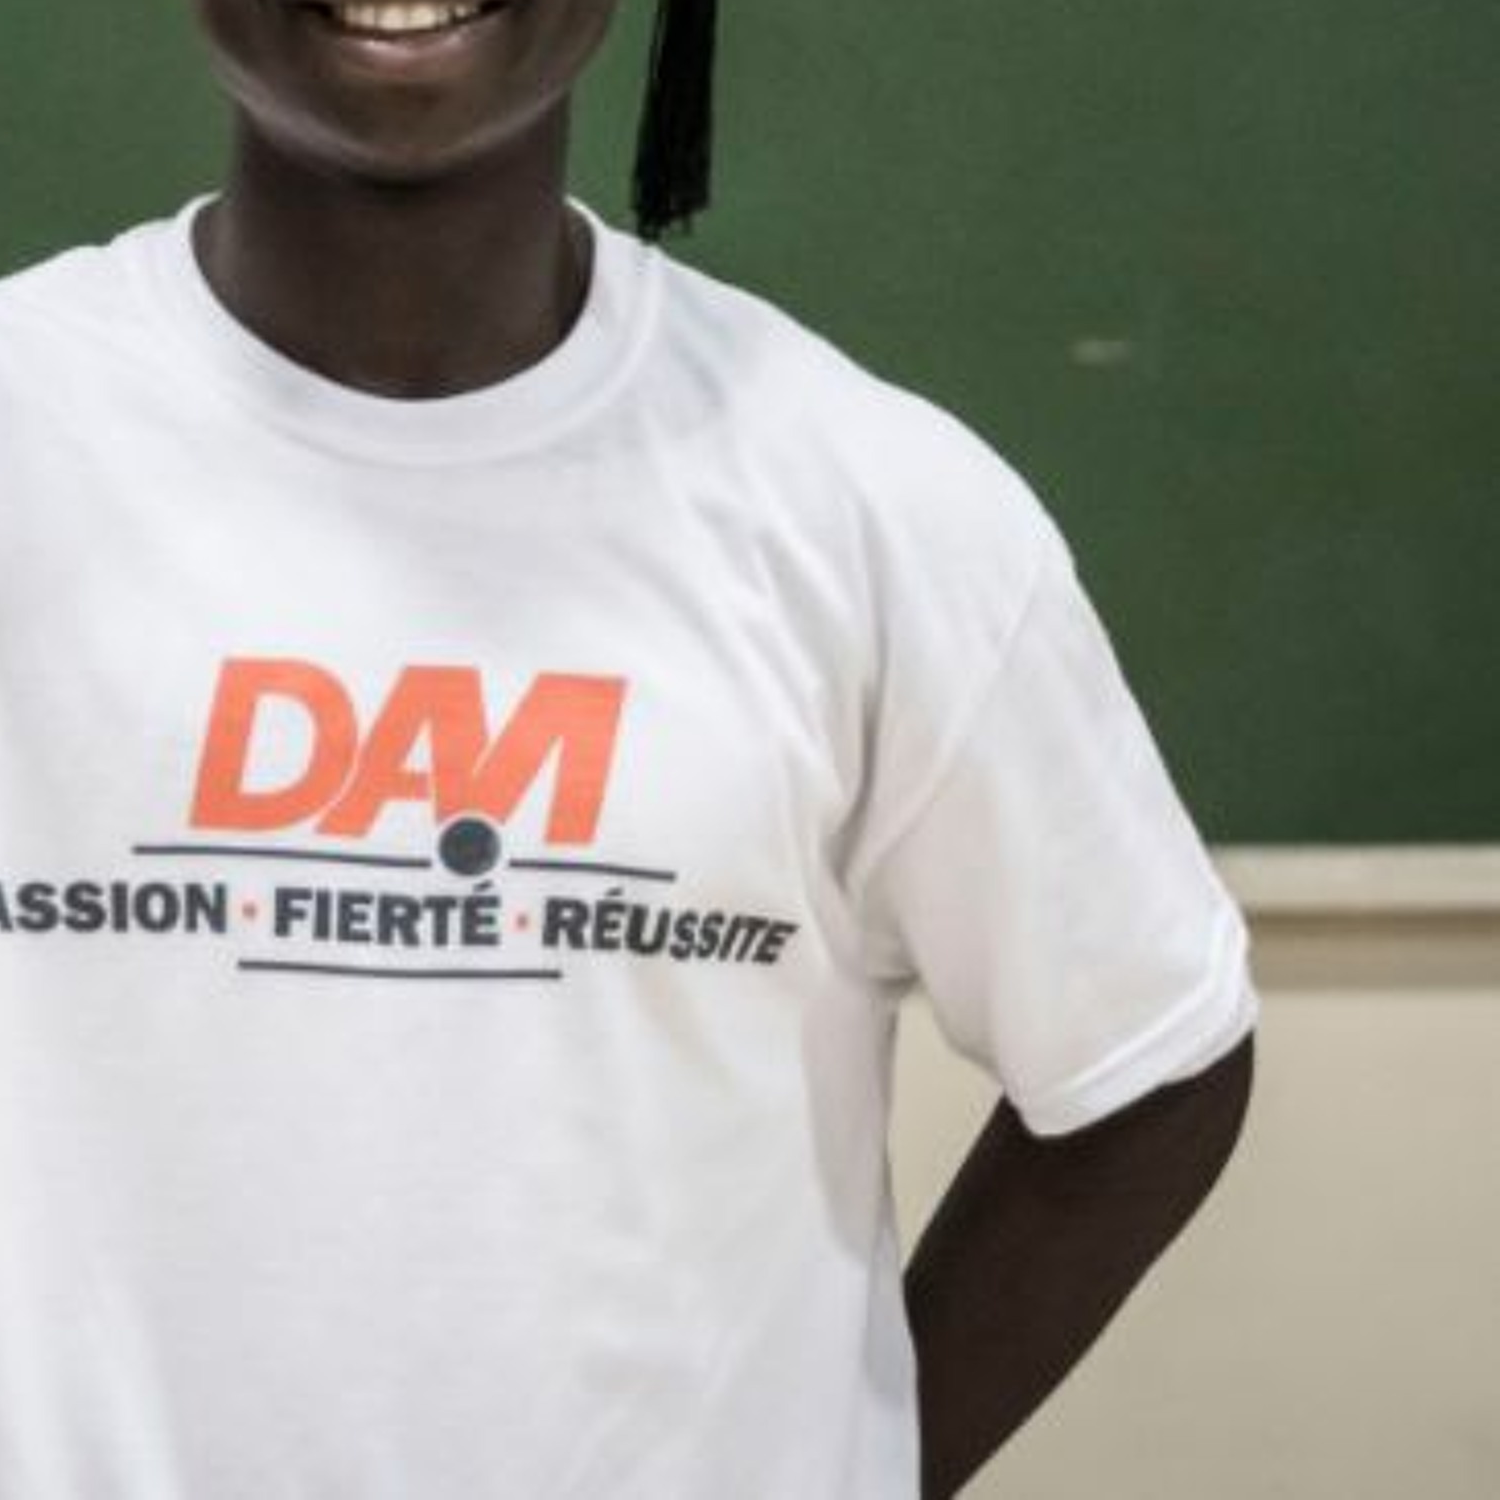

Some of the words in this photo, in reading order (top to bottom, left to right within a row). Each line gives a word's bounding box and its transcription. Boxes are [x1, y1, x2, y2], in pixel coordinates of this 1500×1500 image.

[188, 655, 627, 847] DAM
[272, 879, 501, 948] FIERTÉ
[541, 886, 799, 966] RÉUSSITE
